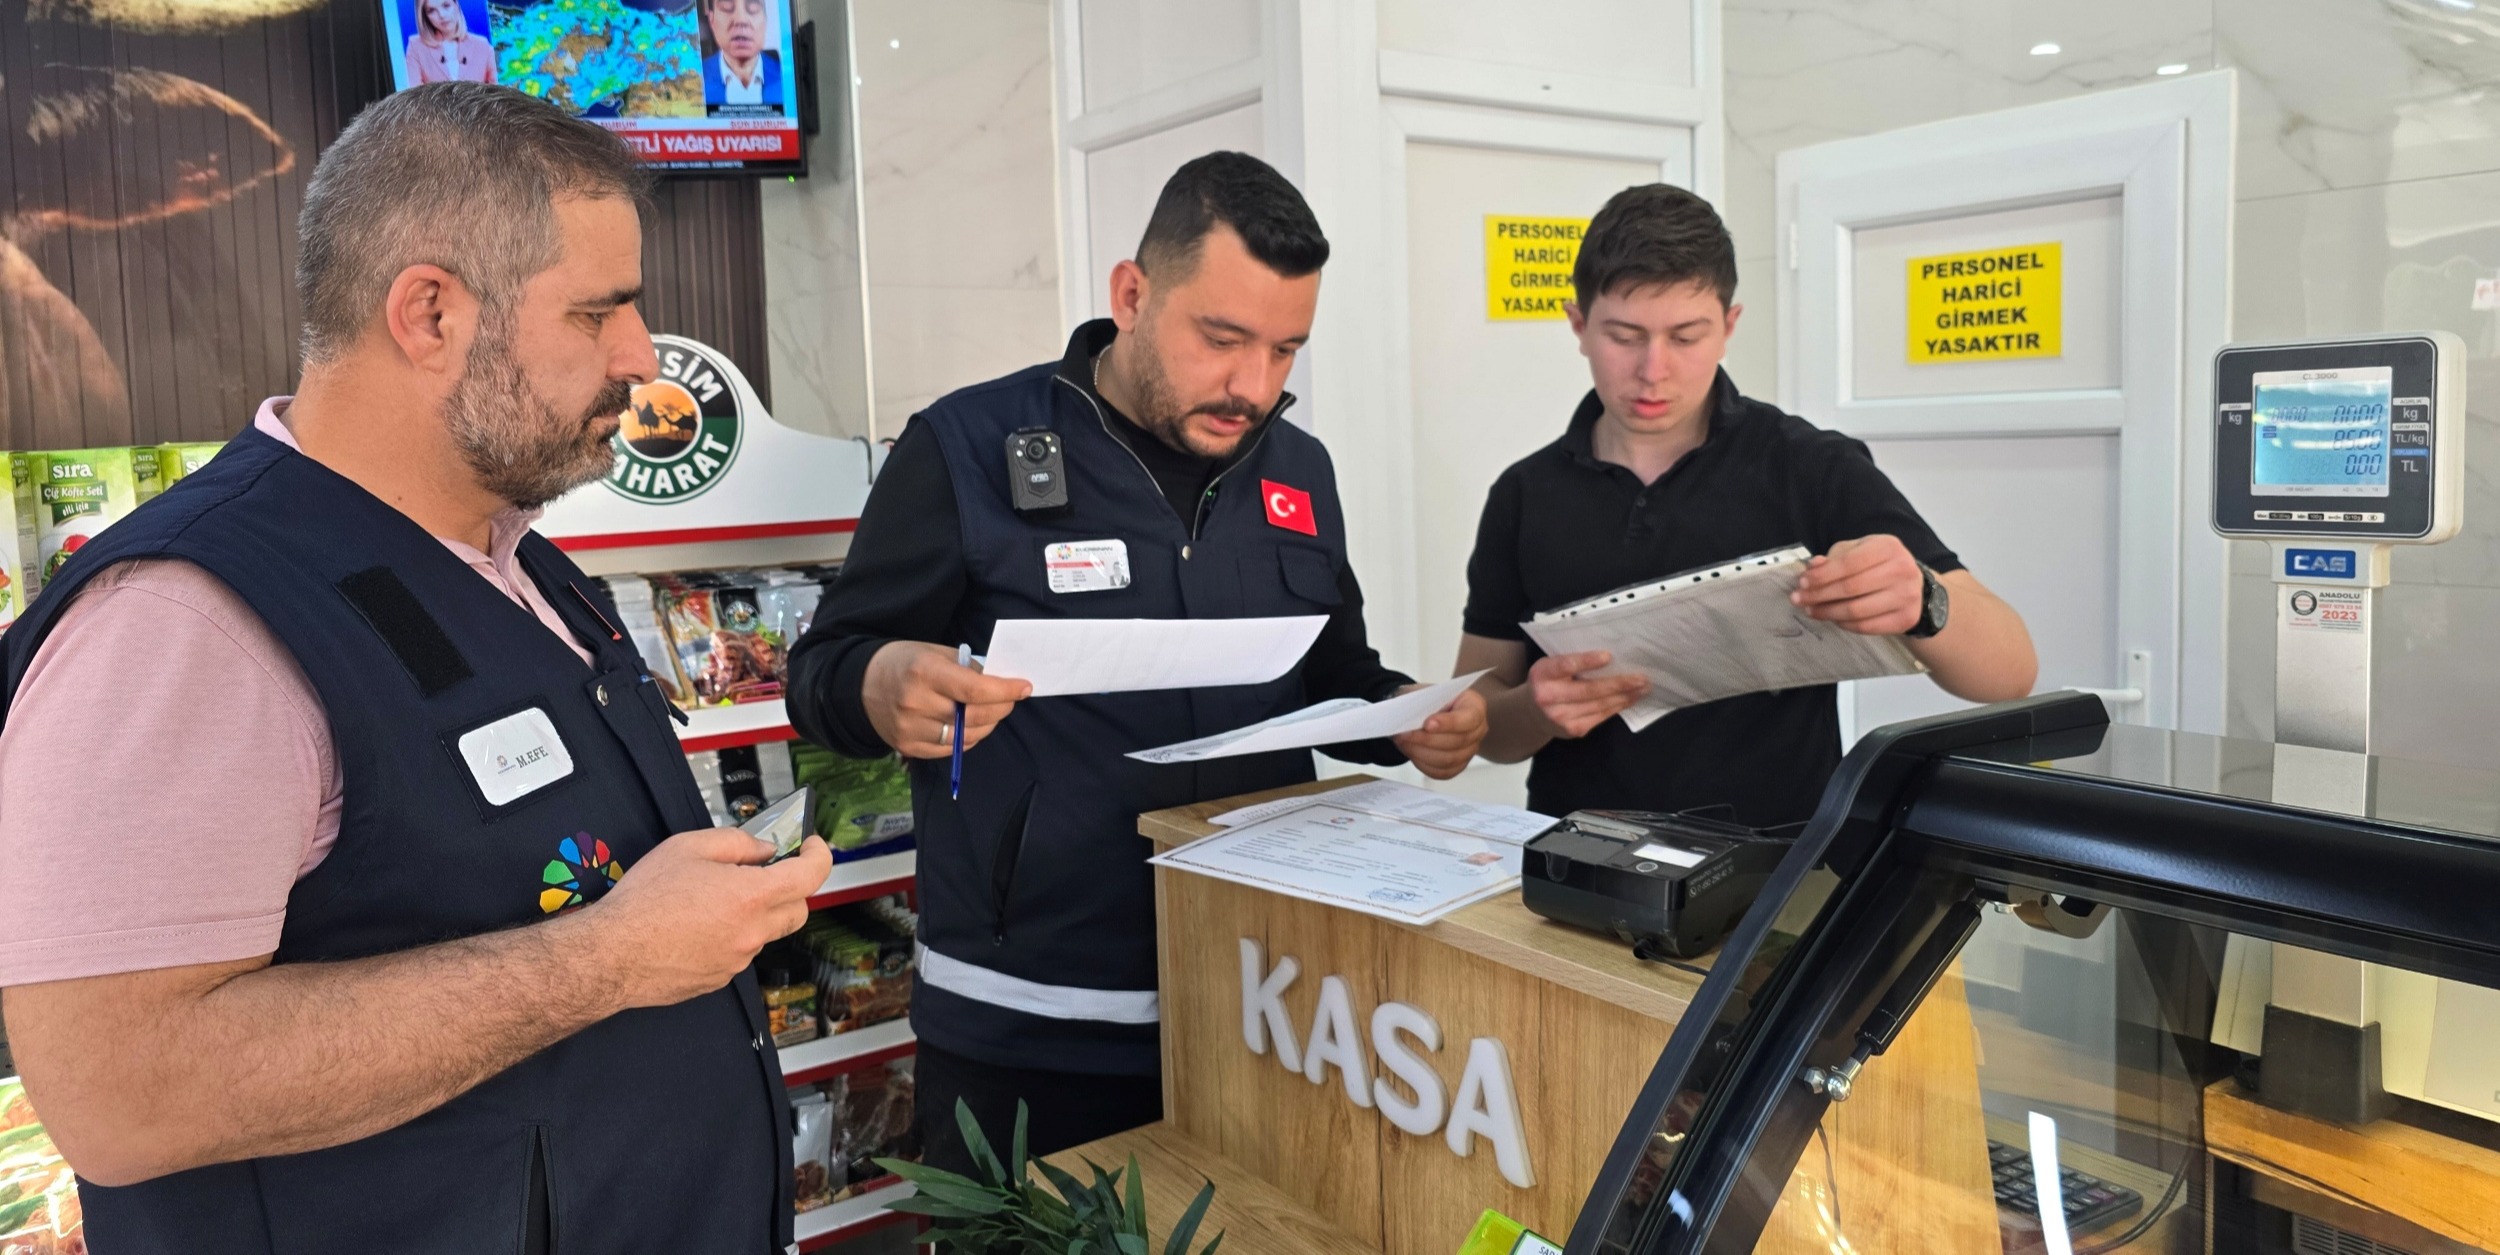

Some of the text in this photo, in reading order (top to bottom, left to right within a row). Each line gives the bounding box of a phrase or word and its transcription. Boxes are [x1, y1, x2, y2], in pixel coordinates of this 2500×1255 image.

[663, 133, 714, 154] YAĞIŞ
[717, 135, 782, 153] UYARISI
[1497, 223, 1584, 240] PERSONEL
[1514, 245, 1571, 263] HARİCİ
[1922, 253, 2044, 279] PERSONEL
[1942, 277, 2021, 303] HARİCİ
[1936, 307, 2027, 329] GİRMEK
[1926, 333, 2040, 355] YASAKTIR
[656, 349, 724, 403] SİM
[2228, 412, 2242, 425] kg
[2403, 407, 2418, 421] kg
[2394, 433, 2425, 445] TL/kg
[611, 432, 729, 496] AHARAT
[2401, 460, 2419, 472] TL
[44, 485, 104, 500] Çiğ Köfte Seti
[2294, 555, 2347, 572] CAS
[2322, 610, 2358, 620] 2023
[515, 746, 549, 768] M.EFE
[1239, 936, 1537, 1189] KASA
